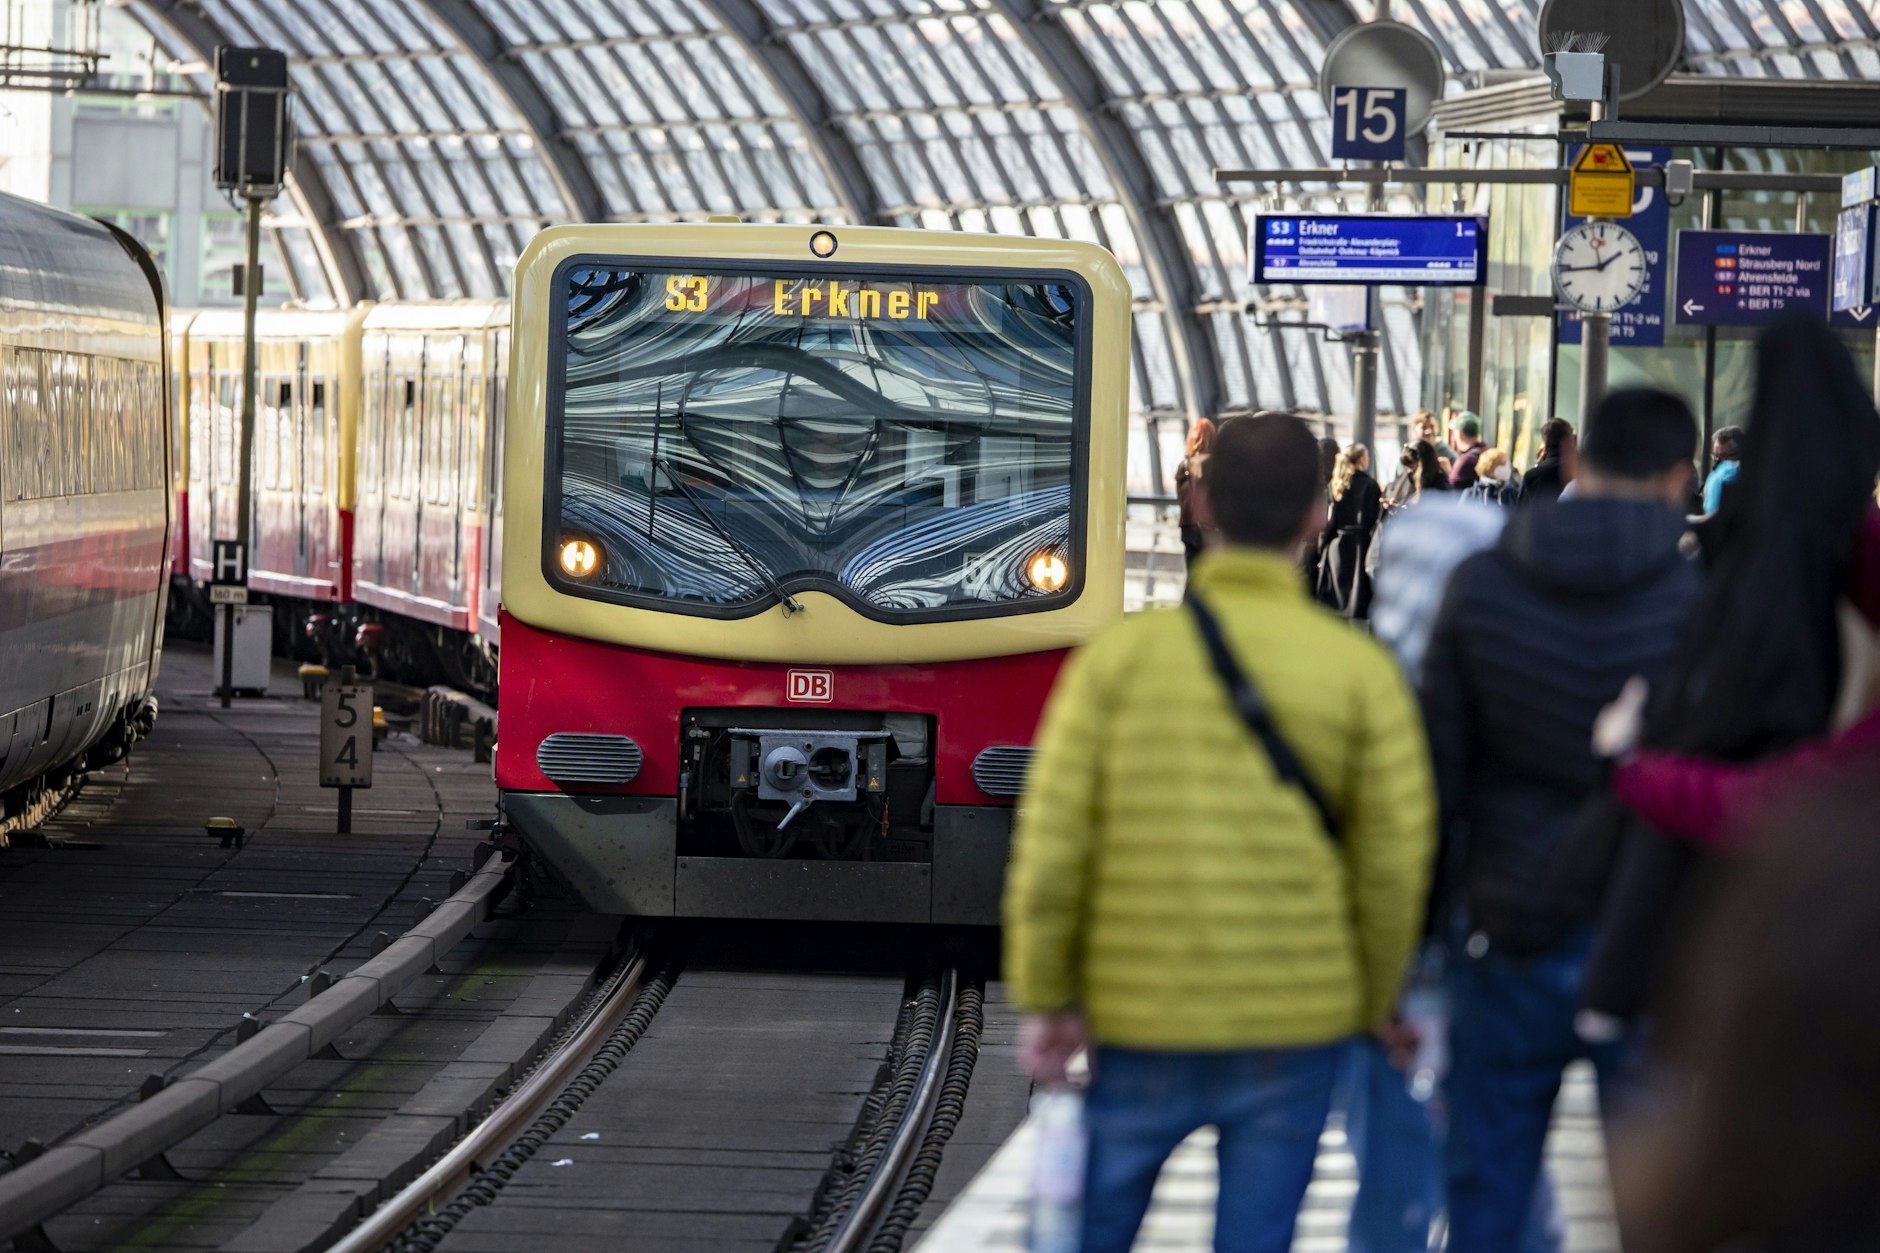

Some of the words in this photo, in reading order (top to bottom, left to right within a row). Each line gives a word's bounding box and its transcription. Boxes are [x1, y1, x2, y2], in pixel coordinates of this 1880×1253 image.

[1336, 89, 1397, 143] 15
[1272, 221, 1290, 235] S3
[1299, 220, 1339, 236] Erkner
[1456, 222, 1463, 237] 1
[1738, 244, 1772, 256] Erkner
[1738, 258, 1793, 272] Strausberg
[1795, 259, 1821, 271] Nord
[1738, 271, 1799, 284] Ahrensfelde
[665, 275, 708, 312] S3
[774, 279, 938, 320] Erkner
[1748, 285, 1770, 297] BER
[1772, 285, 1794, 298] T1-2
[1795, 287, 1811, 298] via
[1748, 298, 1770, 310] BER
[1772, 299, 1785, 310] T5
[1645, 313, 1660, 326] via
[1623, 325, 1635, 338] T5
[217, 544, 243, 580] H
[233, 591, 245, 600] m
[793, 675, 827, 697] DB
[335, 693, 358, 728] 5
[334, 735, 358, 770] 4
